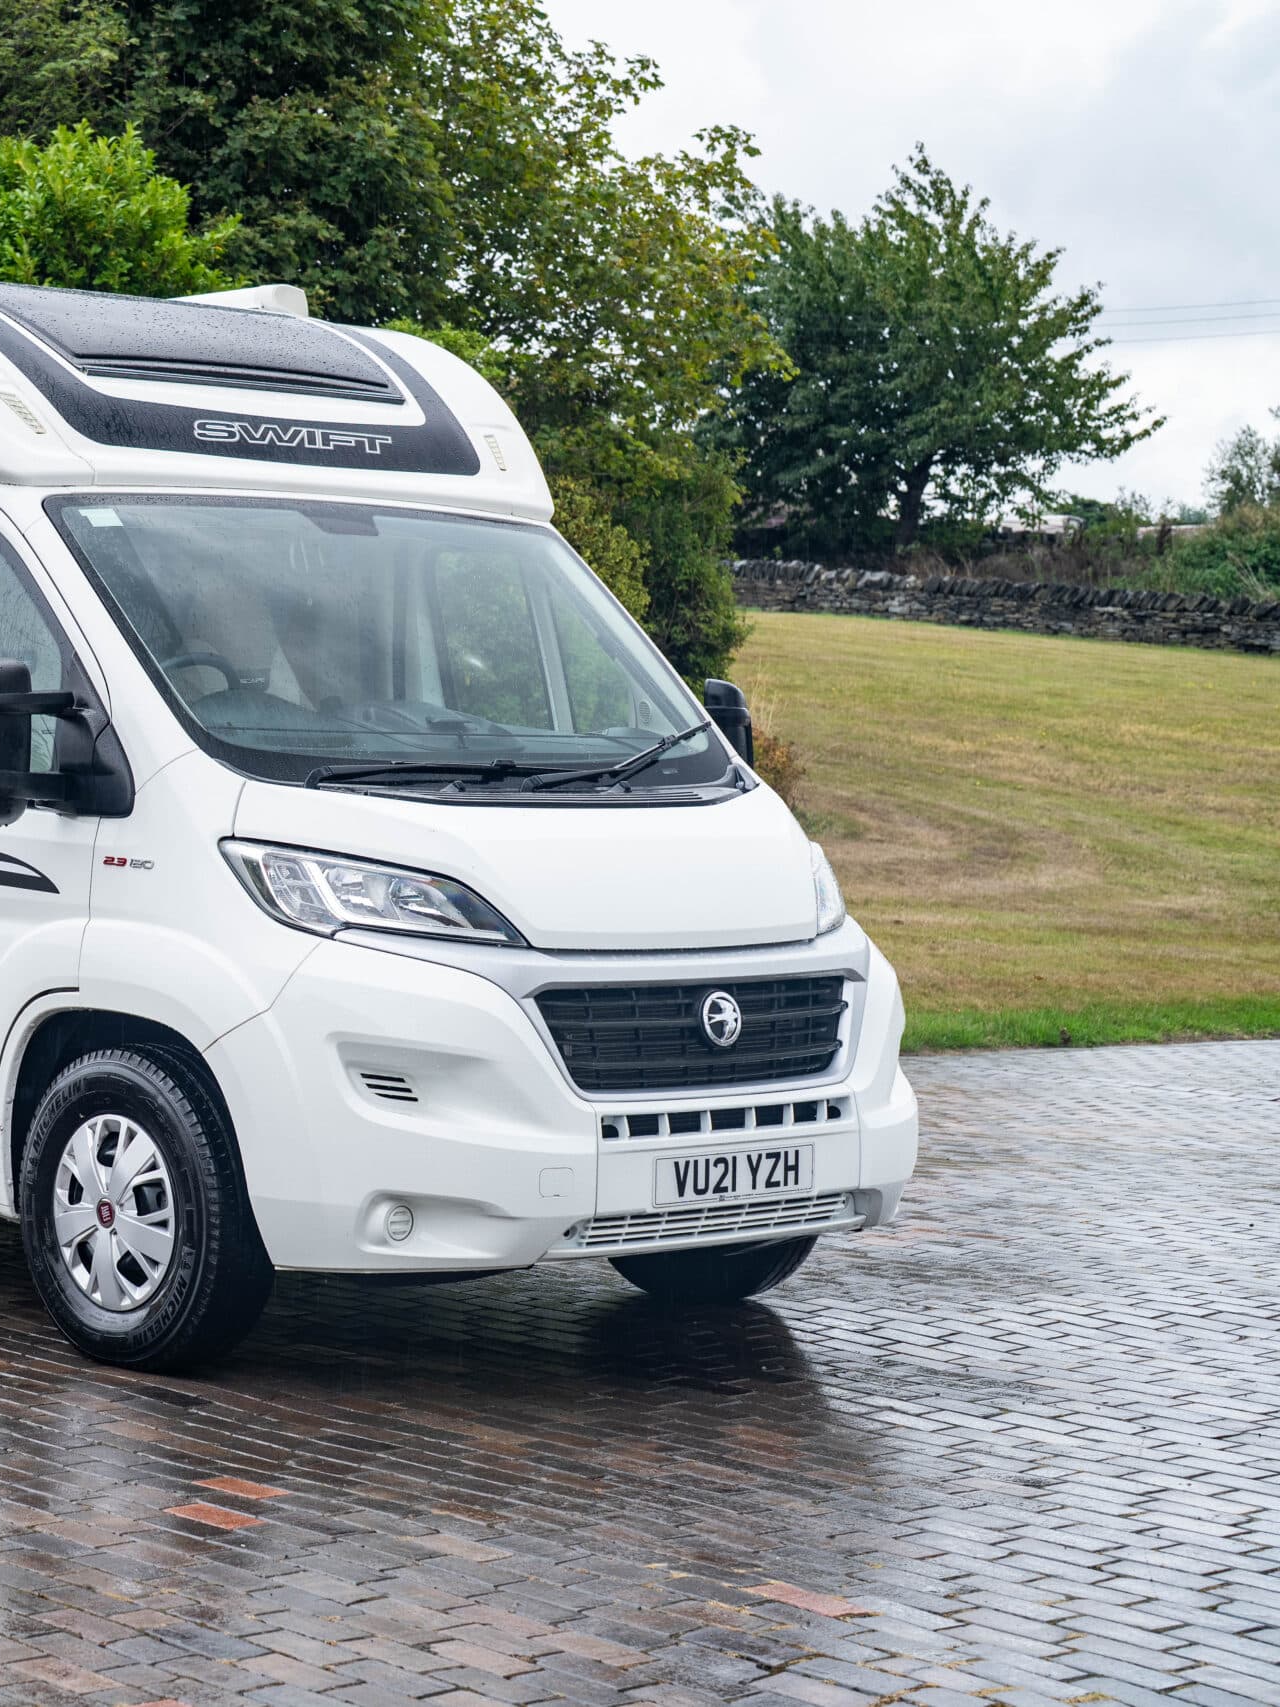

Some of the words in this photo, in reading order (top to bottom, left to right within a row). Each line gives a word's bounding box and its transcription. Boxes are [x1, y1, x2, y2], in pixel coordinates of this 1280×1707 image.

[194, 419, 392, 454] SWIFT
[674, 1155, 737, 1198] VU21
[746, 1149, 799, 1190] YZH
